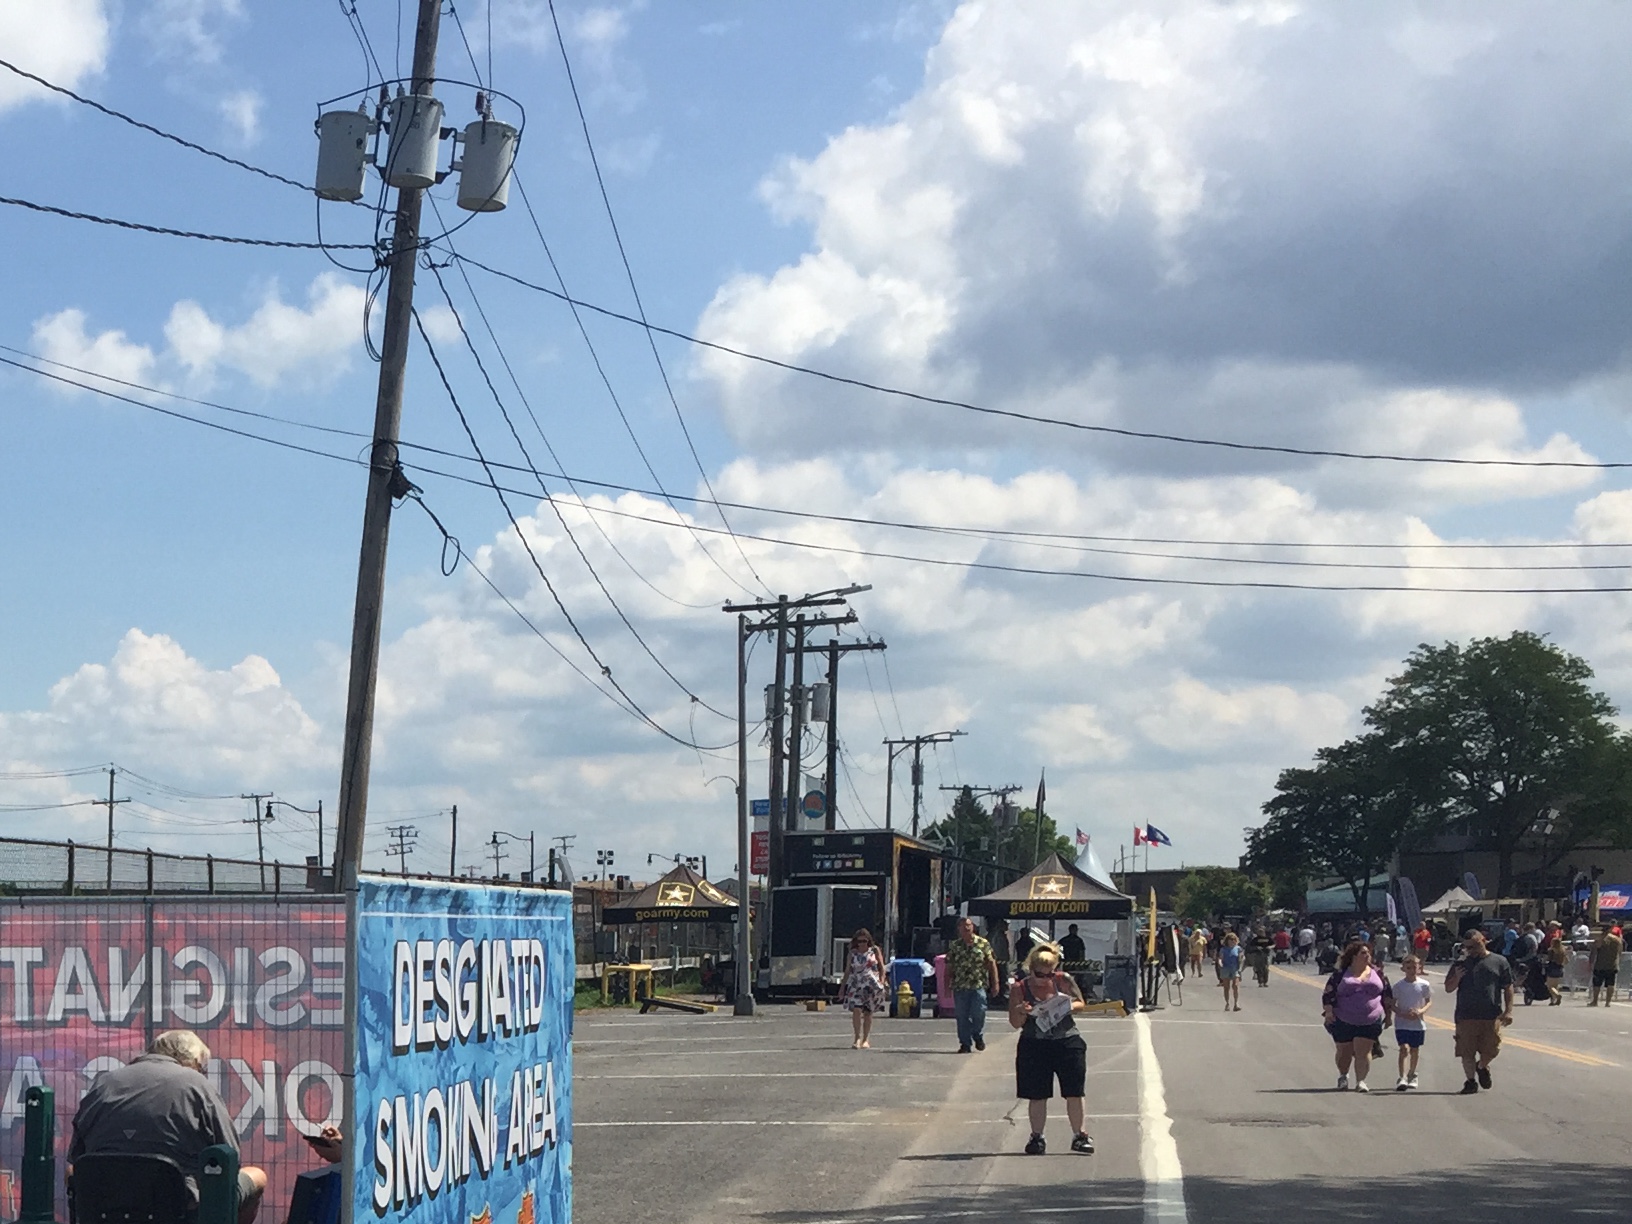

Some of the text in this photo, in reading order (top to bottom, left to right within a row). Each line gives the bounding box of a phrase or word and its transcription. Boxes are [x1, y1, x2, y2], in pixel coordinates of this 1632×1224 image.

[635, 908, 710, 921] goarmy.com
[1009, 900, 1090, 915] goarmy.com
[505, 1061, 557, 1162] AREA
